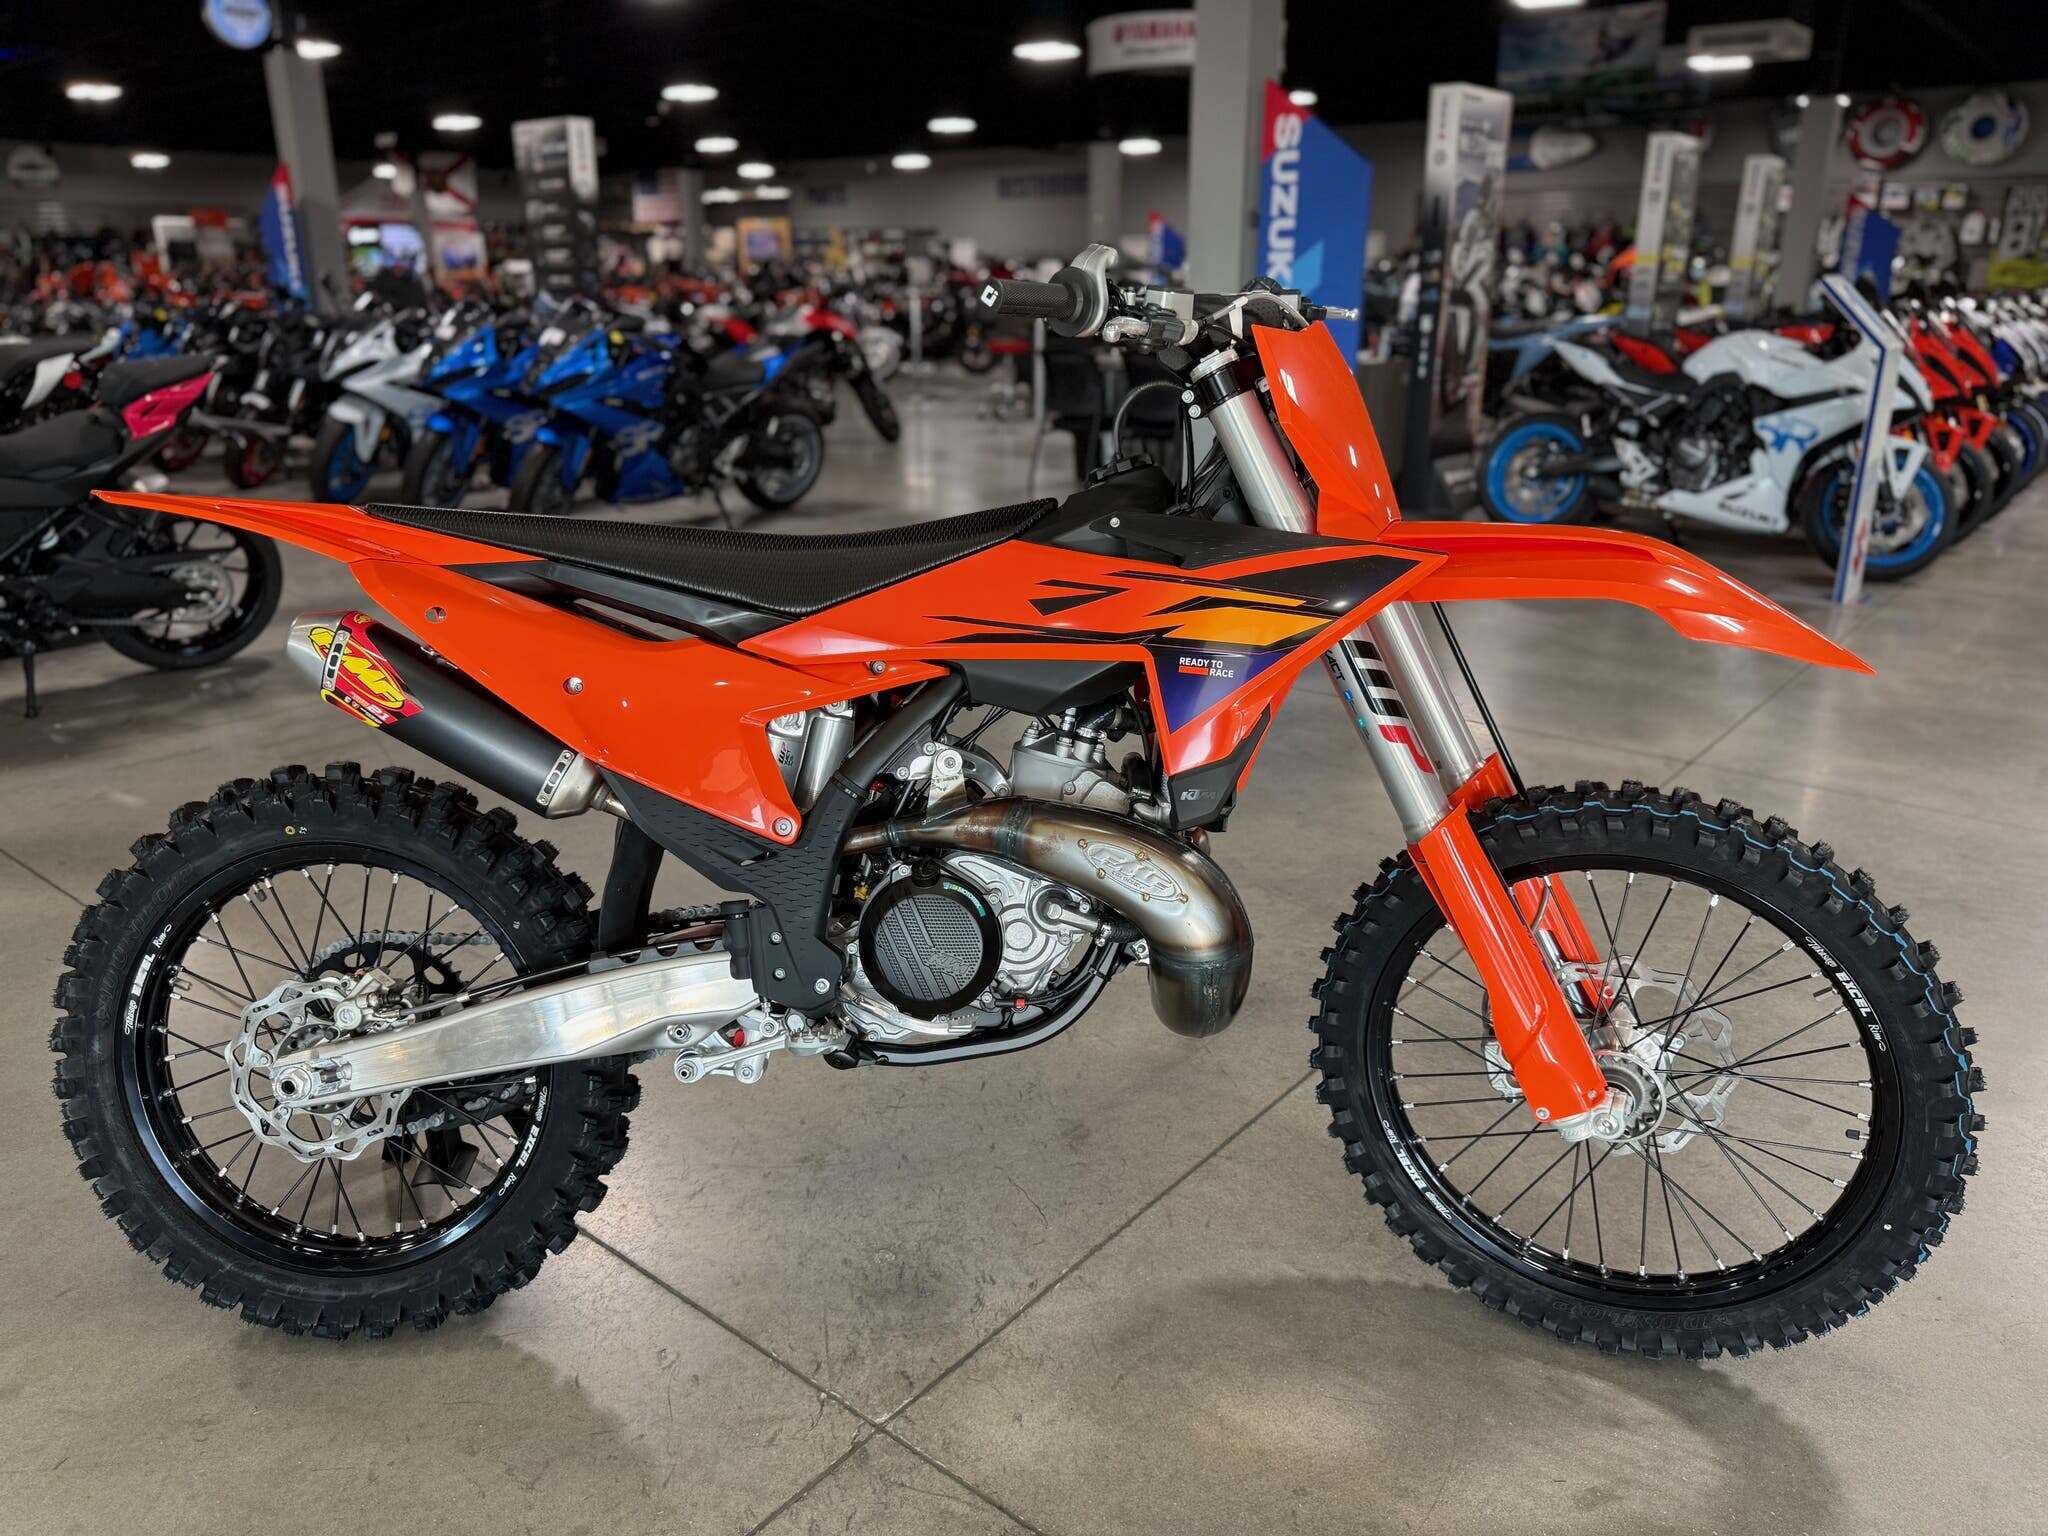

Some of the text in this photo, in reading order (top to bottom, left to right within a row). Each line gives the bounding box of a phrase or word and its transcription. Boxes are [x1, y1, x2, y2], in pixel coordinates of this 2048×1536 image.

[1266, 113, 1303, 281] SUZUK
[308, 628, 405, 704] FMF
[1179, 657, 1223, 669] READY TO
[1209, 668, 1234, 678] RACE
[153, 925, 171, 949] Rim
[1835, 971, 1872, 1017] EXCEL
[1868, 1024, 1886, 1050] Rim
[516, 1124, 540, 1167] EXCEL
[1397, 1148, 1427, 1190] EXCEL
